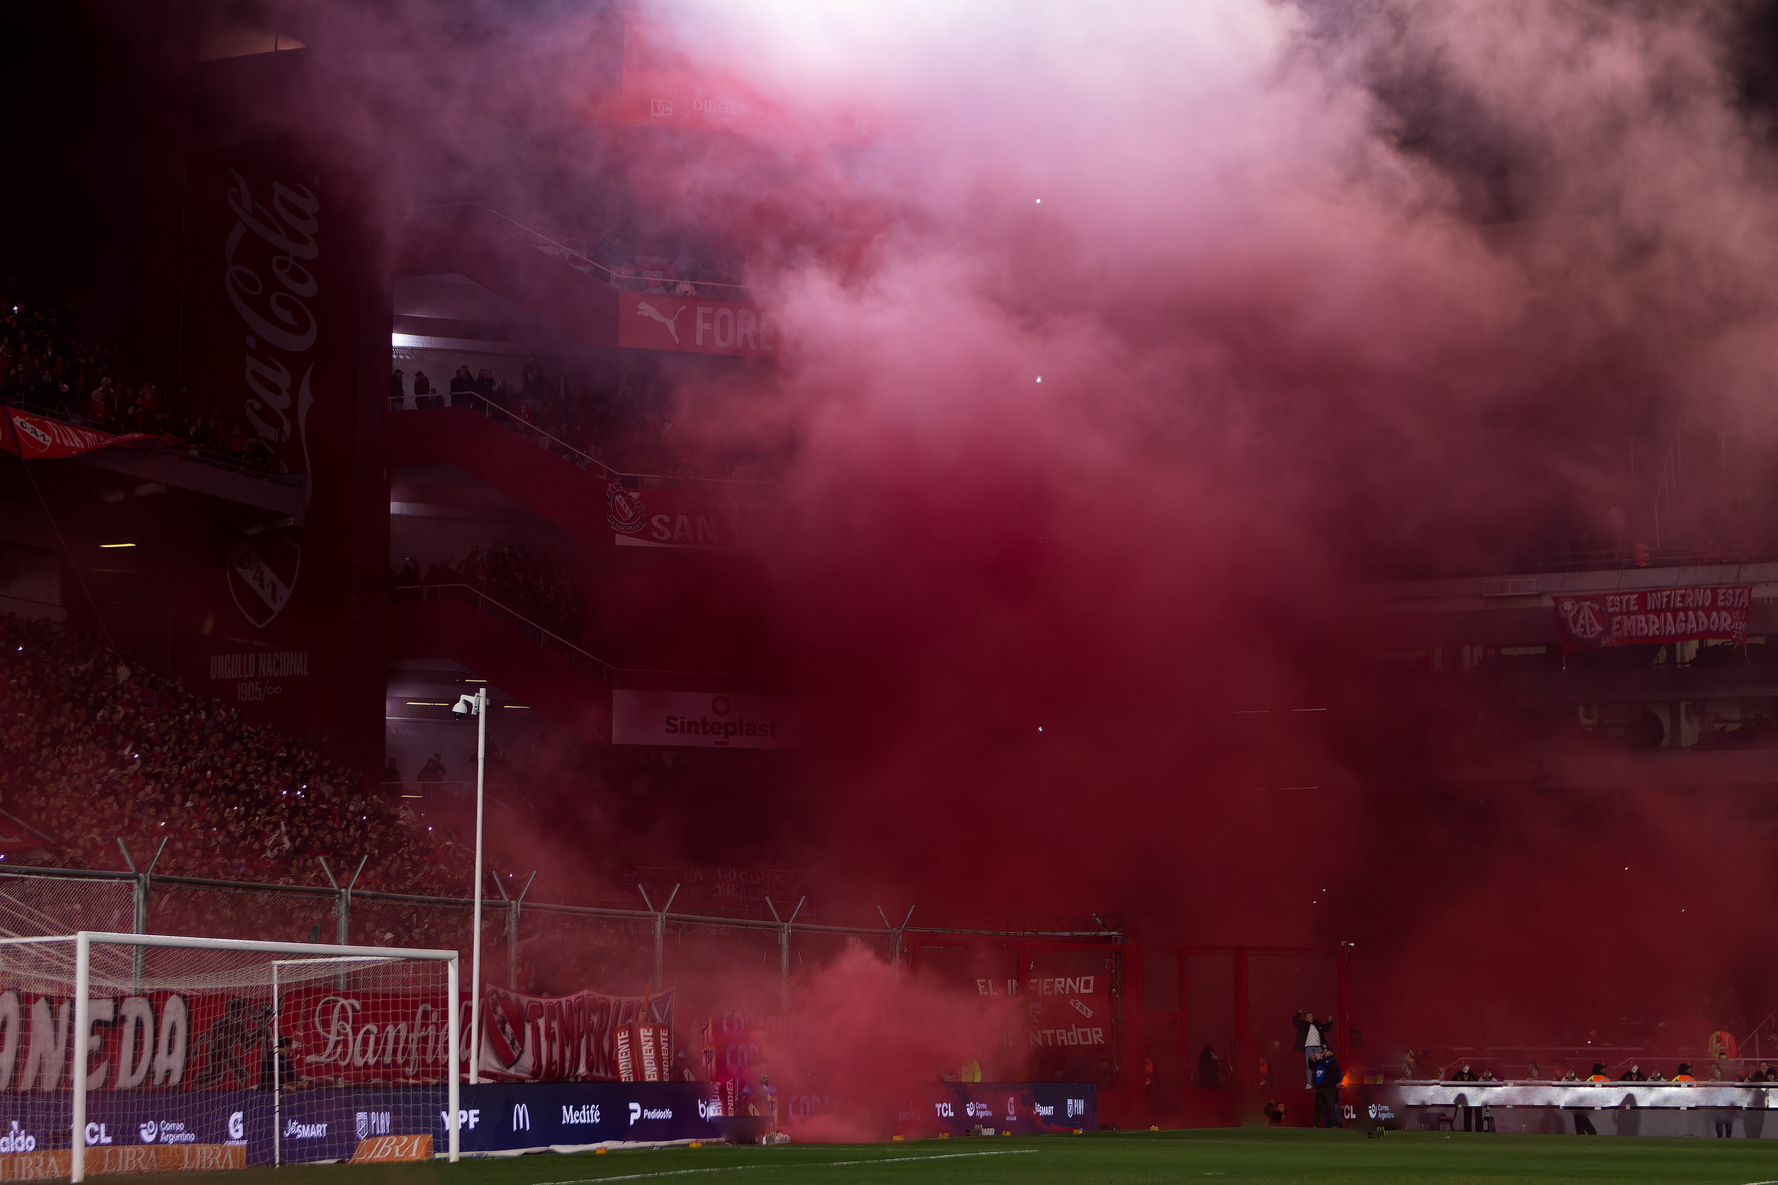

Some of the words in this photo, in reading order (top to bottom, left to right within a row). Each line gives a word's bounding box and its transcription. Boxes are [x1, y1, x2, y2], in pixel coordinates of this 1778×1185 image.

[651, 514, 718, 543] SAN
[1605, 594, 1638, 613] ESTE
[1646, 588, 1712, 611] INFIERNO
[1716, 587, 1749, 609] ESTA
[1610, 610, 1732, 638] EMBRIAGADOR
[210, 653, 256, 679] ORGULLO
[258, 651, 309, 677] NACIONAL
[665, 716, 778, 739] Sinteplast
[976, 978, 999, 996] EL
[561, 1104, 601, 1126] Medifé
[643, 1108, 673, 1121] PedidosYa
[935, 1102, 954, 1118] TCL
[1341, 1104, 1357, 1120] CL
[70, 1122, 112, 1146] CL
[159, 1131, 196, 1146] Argentino
[282, 1118, 328, 1139] JetSMART
[181, 1146, 235, 1171] LIBRA
[353, 1135, 420, 1160] LIBRA
[103, 1147, 160, 1173] LIBRA
